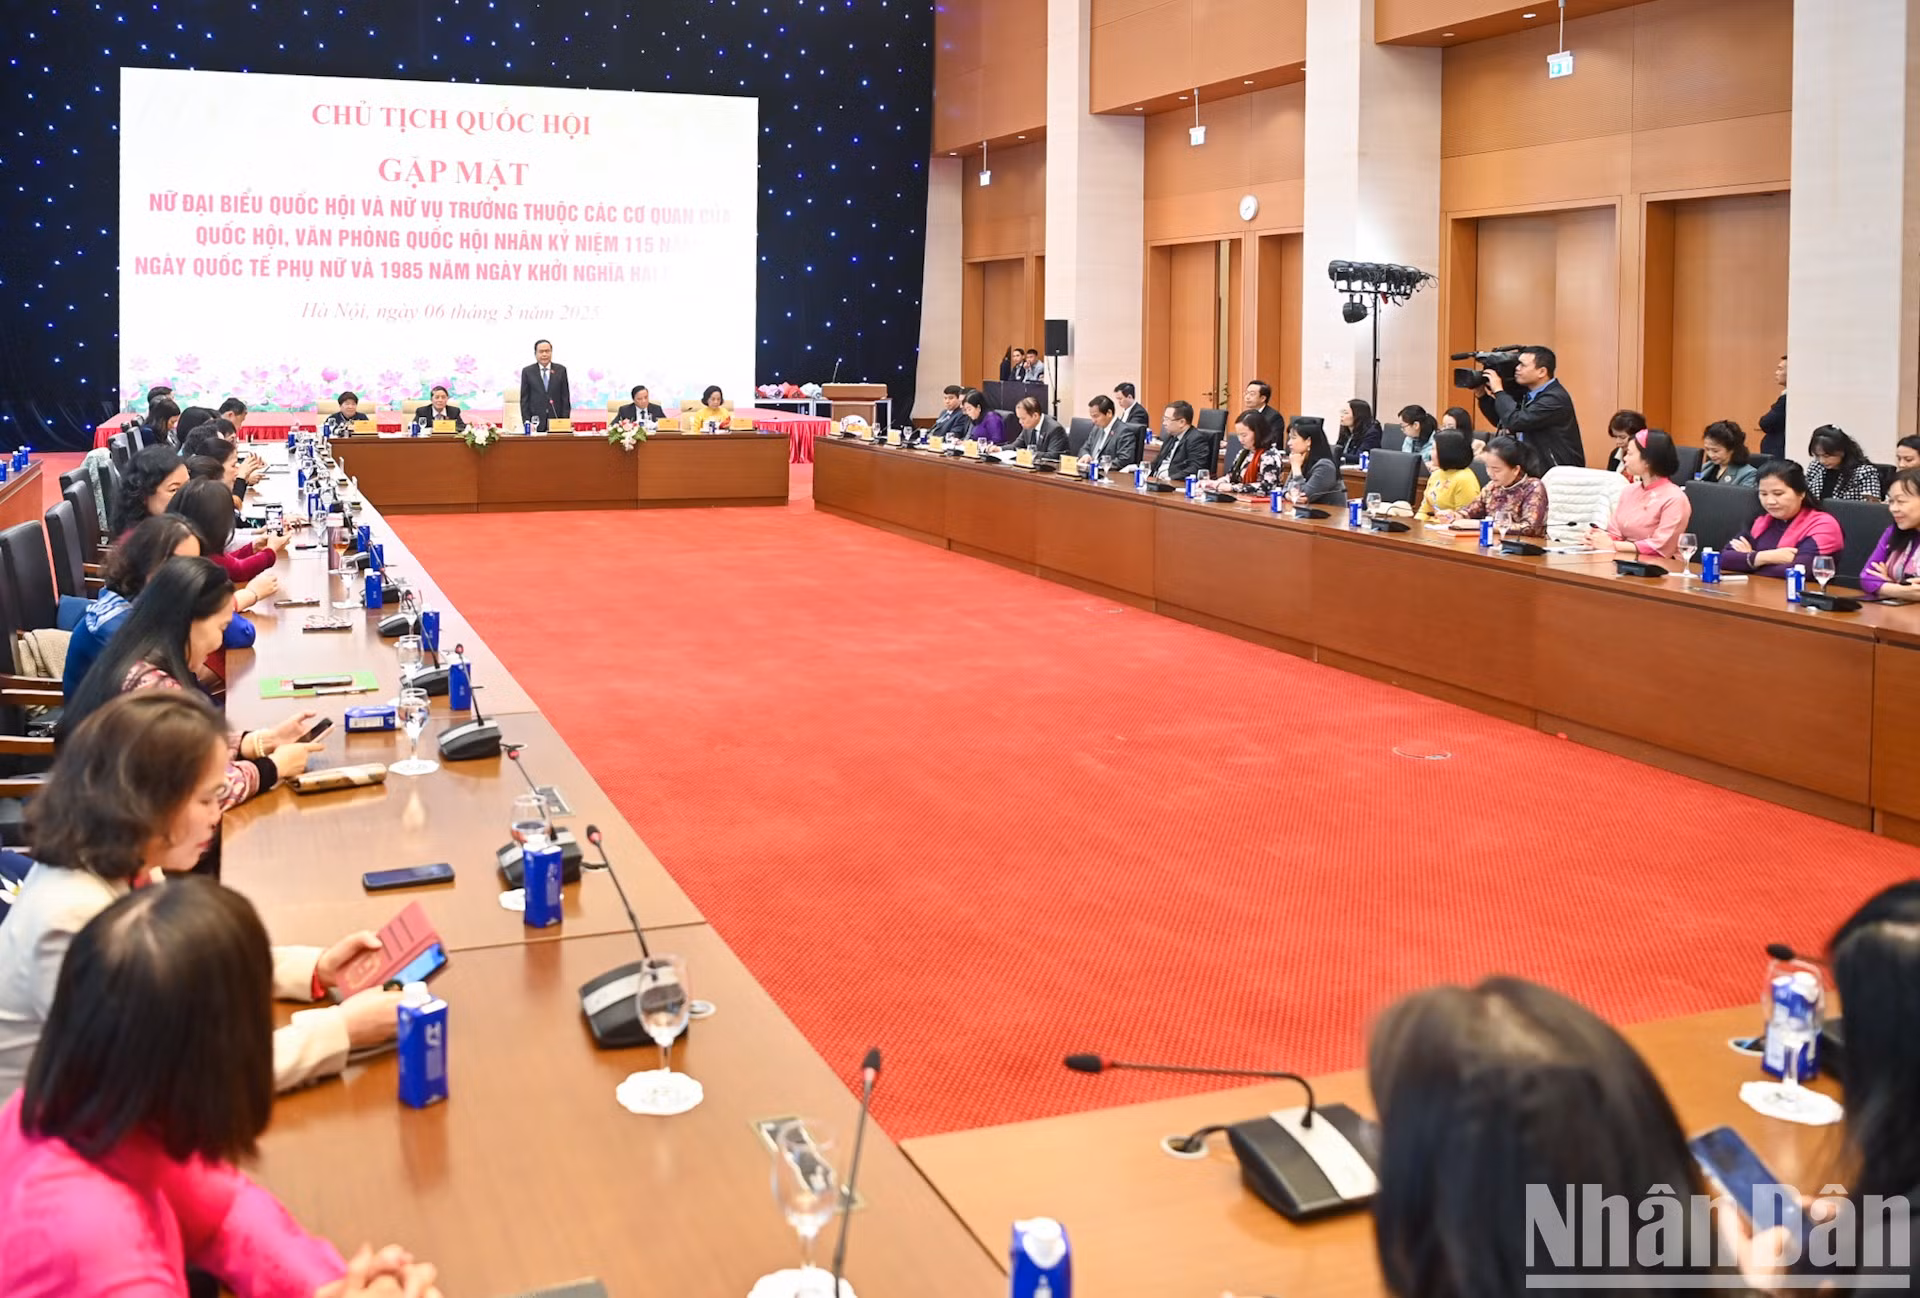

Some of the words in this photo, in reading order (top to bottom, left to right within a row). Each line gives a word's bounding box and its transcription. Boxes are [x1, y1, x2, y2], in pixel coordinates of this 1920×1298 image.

[312, 101, 371, 126] CHỦ
[380, 107, 448, 133] TỊCH
[456, 106, 534, 135] QUỐC
[543, 113, 591, 139] HỘI
[378, 156, 447, 189] GẶP
[456, 159, 529, 191] MẶT
[150, 190, 177, 212] NỮ
[182, 194, 213, 216] ĐẠI
[221, 188, 262, 214] BIỂU
[269, 190, 318, 216] QUỐC
[326, 195, 355, 220] HỘI
[362, 195, 383, 217] VÀ
[391, 197, 416, 218] NỮ
[422, 201, 442, 222] VỤ
[449, 197, 517, 220] TRƯỞNG
[524, 201, 578, 225] THUỘC
[584, 201, 617, 223] CÁC
[623, 205, 645, 225] CƠ
[651, 207, 694, 226] QUAN
[196, 221, 245, 246] QUỐC
[252, 224, 288, 250] HỘI,
[296, 225, 332, 246] VĂN
[339, 226, 399, 248] PHÒNG
[406, 225, 453, 250] QUỐC
[460, 229, 487, 253] HỘI
[494, 230, 542, 251] NHÂN
[549, 228, 568, 252] KỶ
[575, 232, 618, 255] NIỆM
[626, 236, 653, 253] 115
[135, 253, 185, 276] NGÀY
[193, 252, 243, 278] QUỐC
[250, 253, 271, 277] TẾ
[277, 259, 313, 281] PHỤ
[320, 257, 347, 278] NỮ
[351, 258, 374, 279] VÀ
[381, 262, 423, 279] 1985
[430, 258, 469, 280] NĂM
[476, 259, 522, 281] NGÀY
[528, 259, 567, 282] KHỞI
[573, 261, 624, 283] NGHĨA
[302, 302, 328, 318] Hà
[377, 304, 418, 323] ngày
[425, 303, 445, 319] 06
[451, 303, 497, 322] tháng
[504, 304, 514, 320] 3
[519, 305, 554, 320] năm
